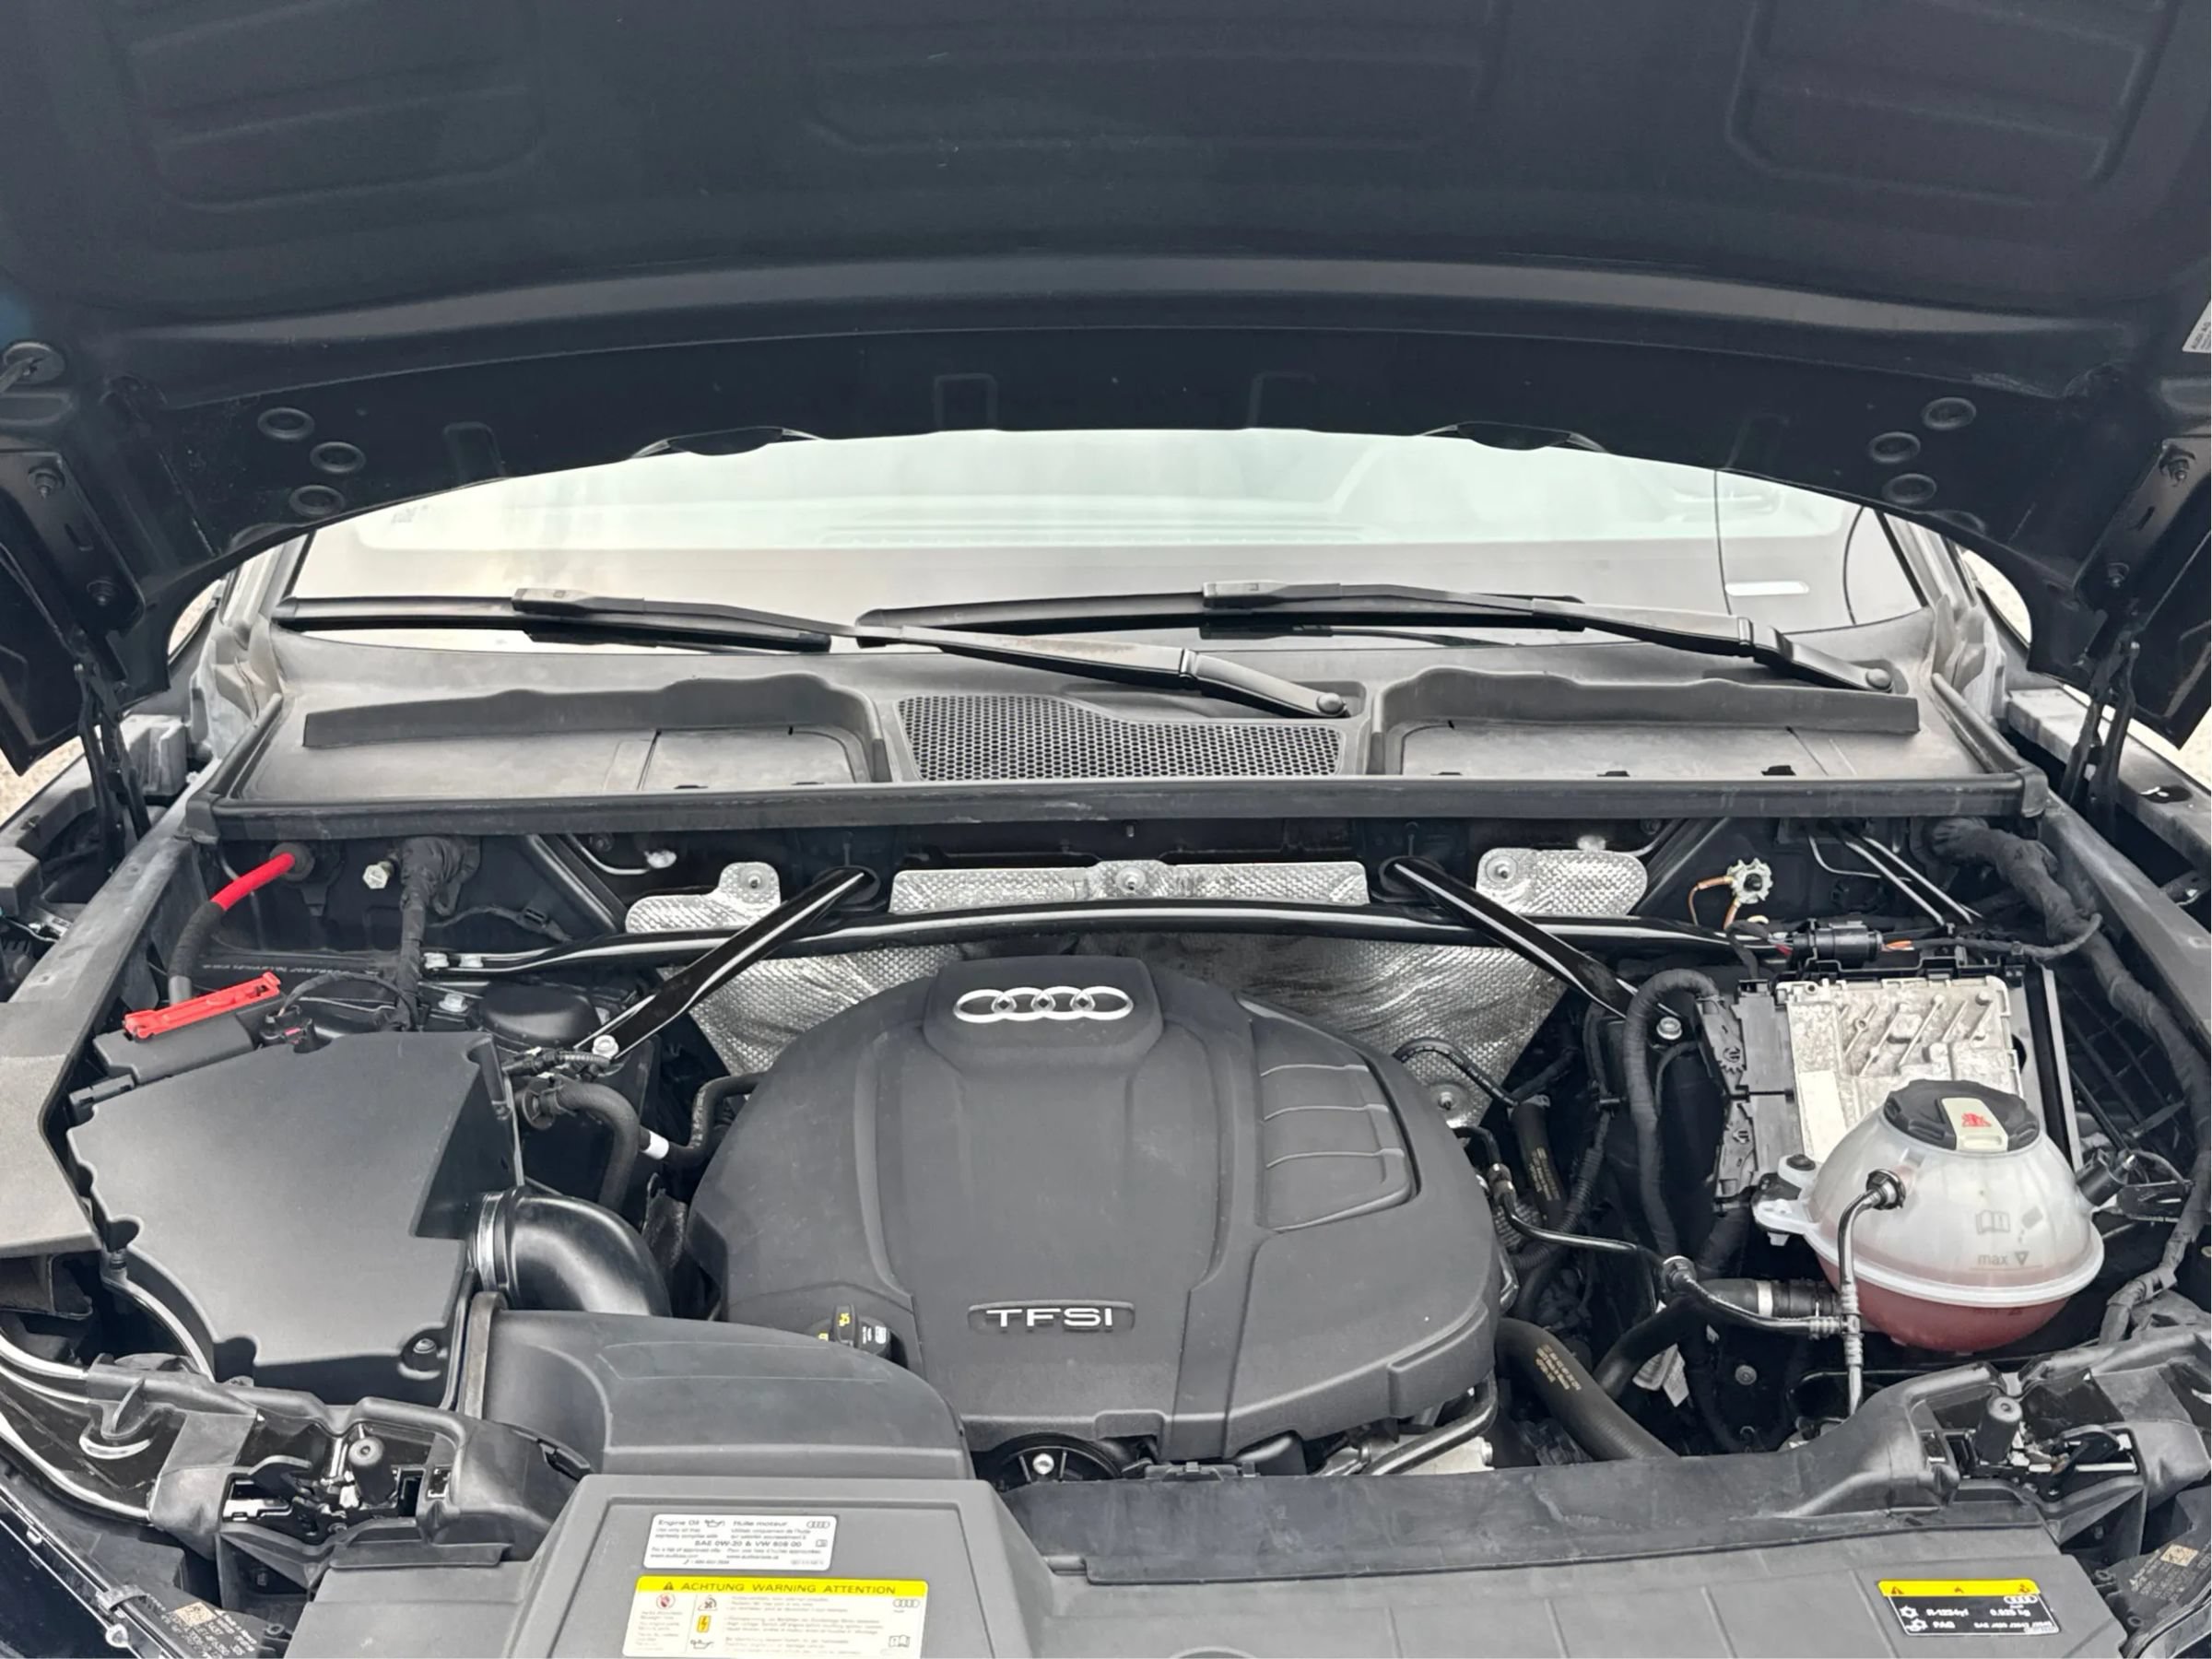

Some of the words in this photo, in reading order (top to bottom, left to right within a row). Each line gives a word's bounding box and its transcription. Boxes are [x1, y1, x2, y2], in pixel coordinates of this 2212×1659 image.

[1977, 1254, 2008, 1265] max
[985, 1307, 1113, 1327] TFSI
[681, 1582, 745, 1592] ACHTUNG
[752, 1583, 817, 1593] WARNING
[823, 1584, 896, 1594] ATTENTION
